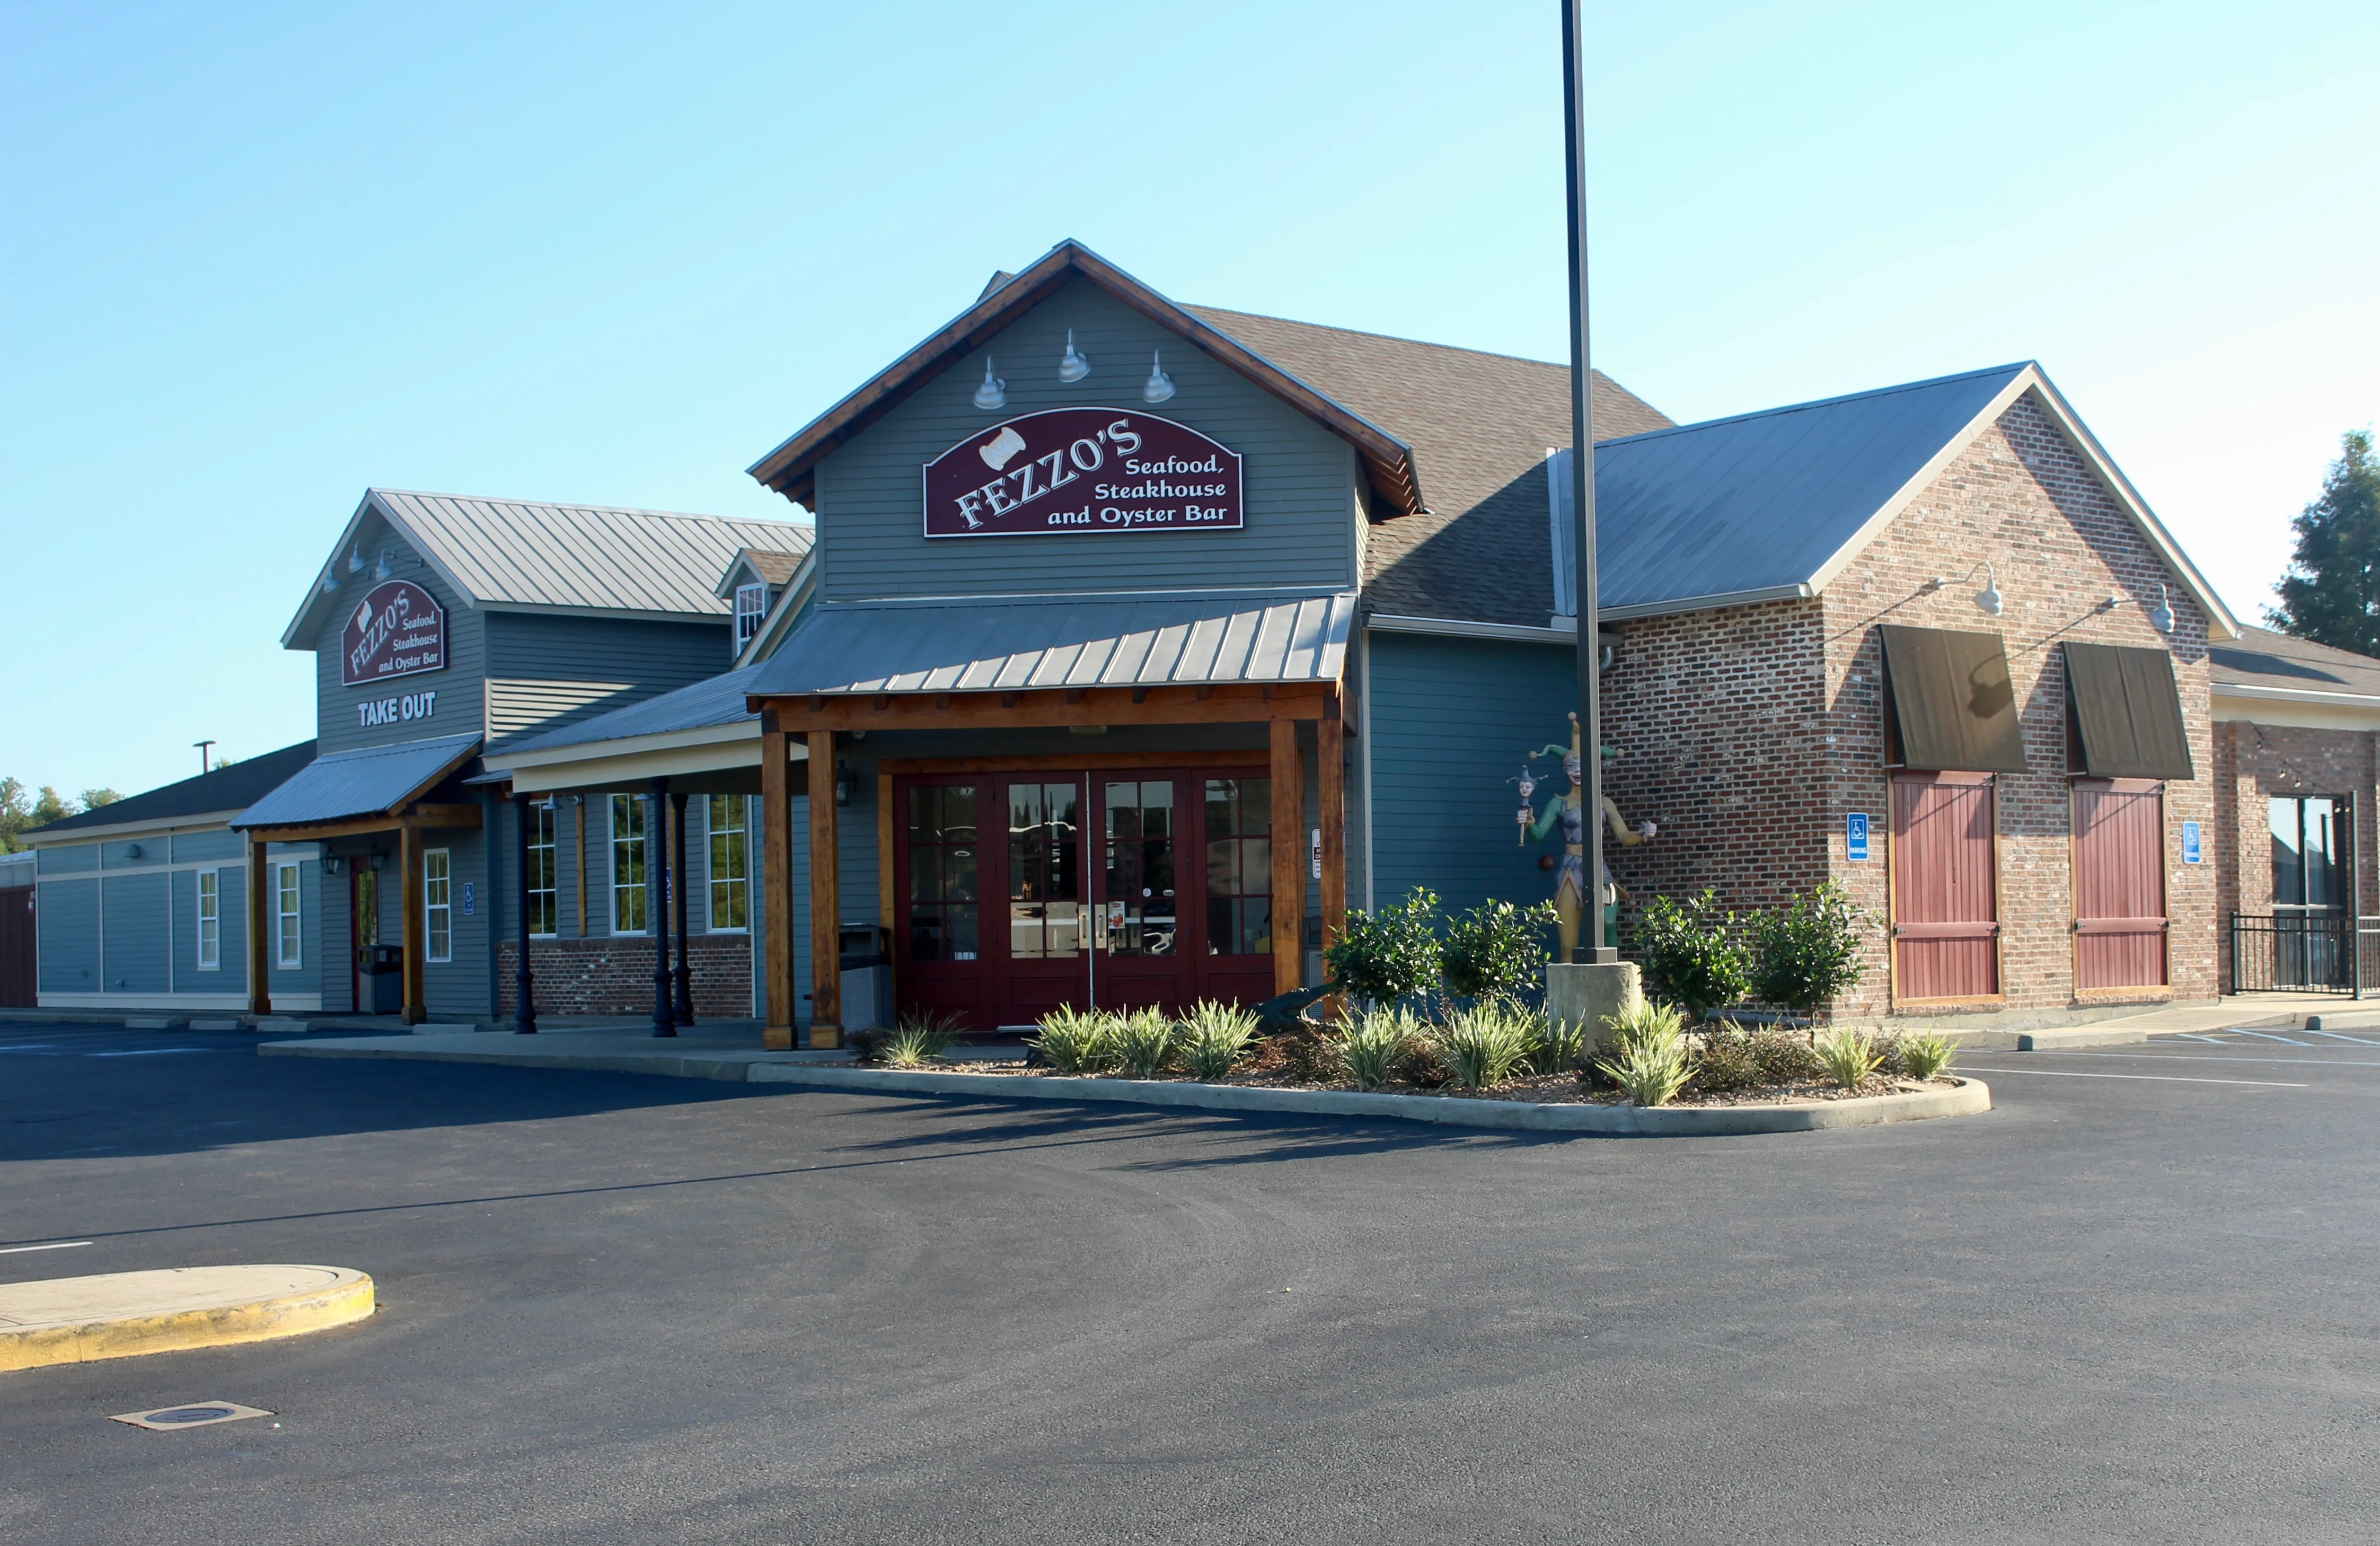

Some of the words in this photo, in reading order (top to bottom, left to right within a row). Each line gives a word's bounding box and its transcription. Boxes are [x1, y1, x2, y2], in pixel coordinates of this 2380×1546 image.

[955, 419, 1141, 529] FEZZO'S
[1126, 455, 1224, 475] Seafood,
[1095, 480, 1226, 500] Steakhouse
[1048, 506, 1090, 525] and
[1100, 506, 1176, 527] Oyster
[1186, 506, 1227, 522] Bar
[403, 611, 437, 630] Seafood,
[350, 589, 409, 677] FEZZO'S
[393, 634, 438, 651] Steakhouse
[379, 657, 393, 673] and
[395, 655, 421, 671] Oyster
[424, 652, 438, 665] Bar
[358, 698, 398, 726] TAKE
[402, 691, 436, 720] OUT
